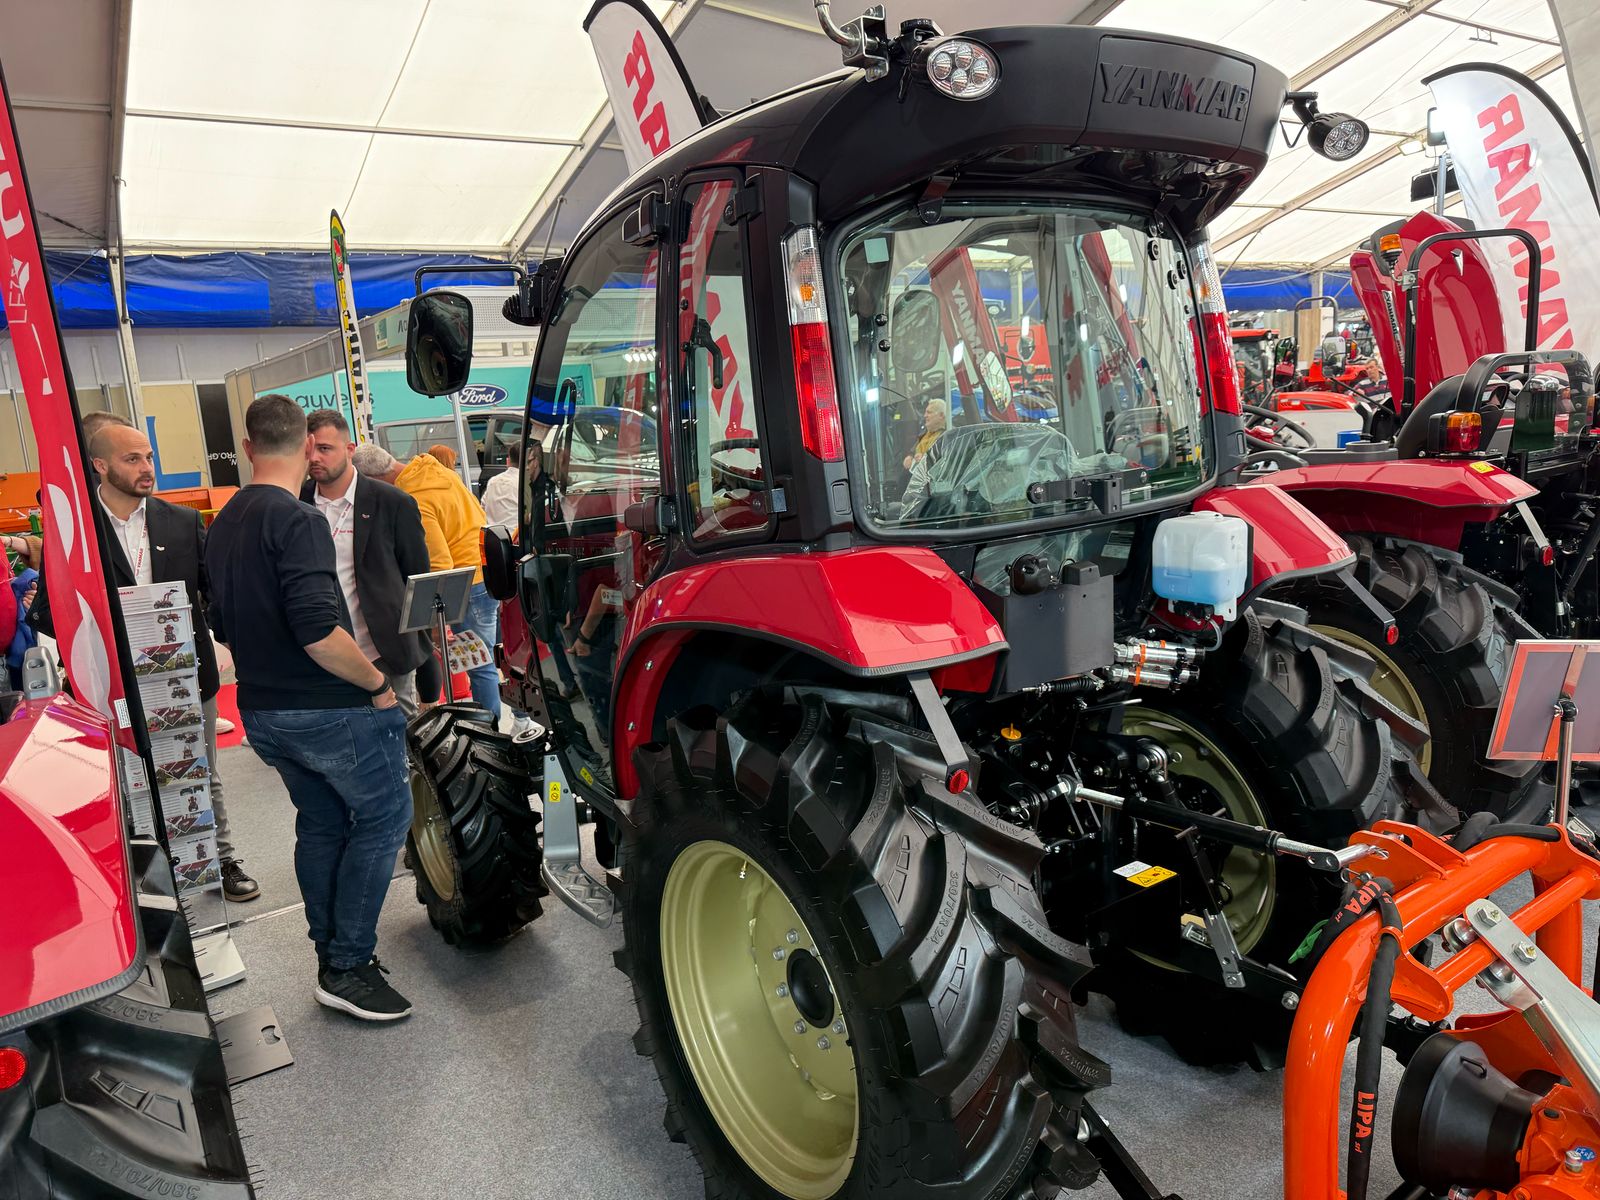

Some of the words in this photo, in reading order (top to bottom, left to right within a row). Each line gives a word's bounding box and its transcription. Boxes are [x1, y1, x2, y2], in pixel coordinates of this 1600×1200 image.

[1100, 62, 1250, 122] YANMAR
[951, 280, 985, 365] YANMA
[459, 387, 496, 404] Ford
[1344, 881, 1381, 914] LIPA
[1355, 1091, 1375, 1138] LIPA
